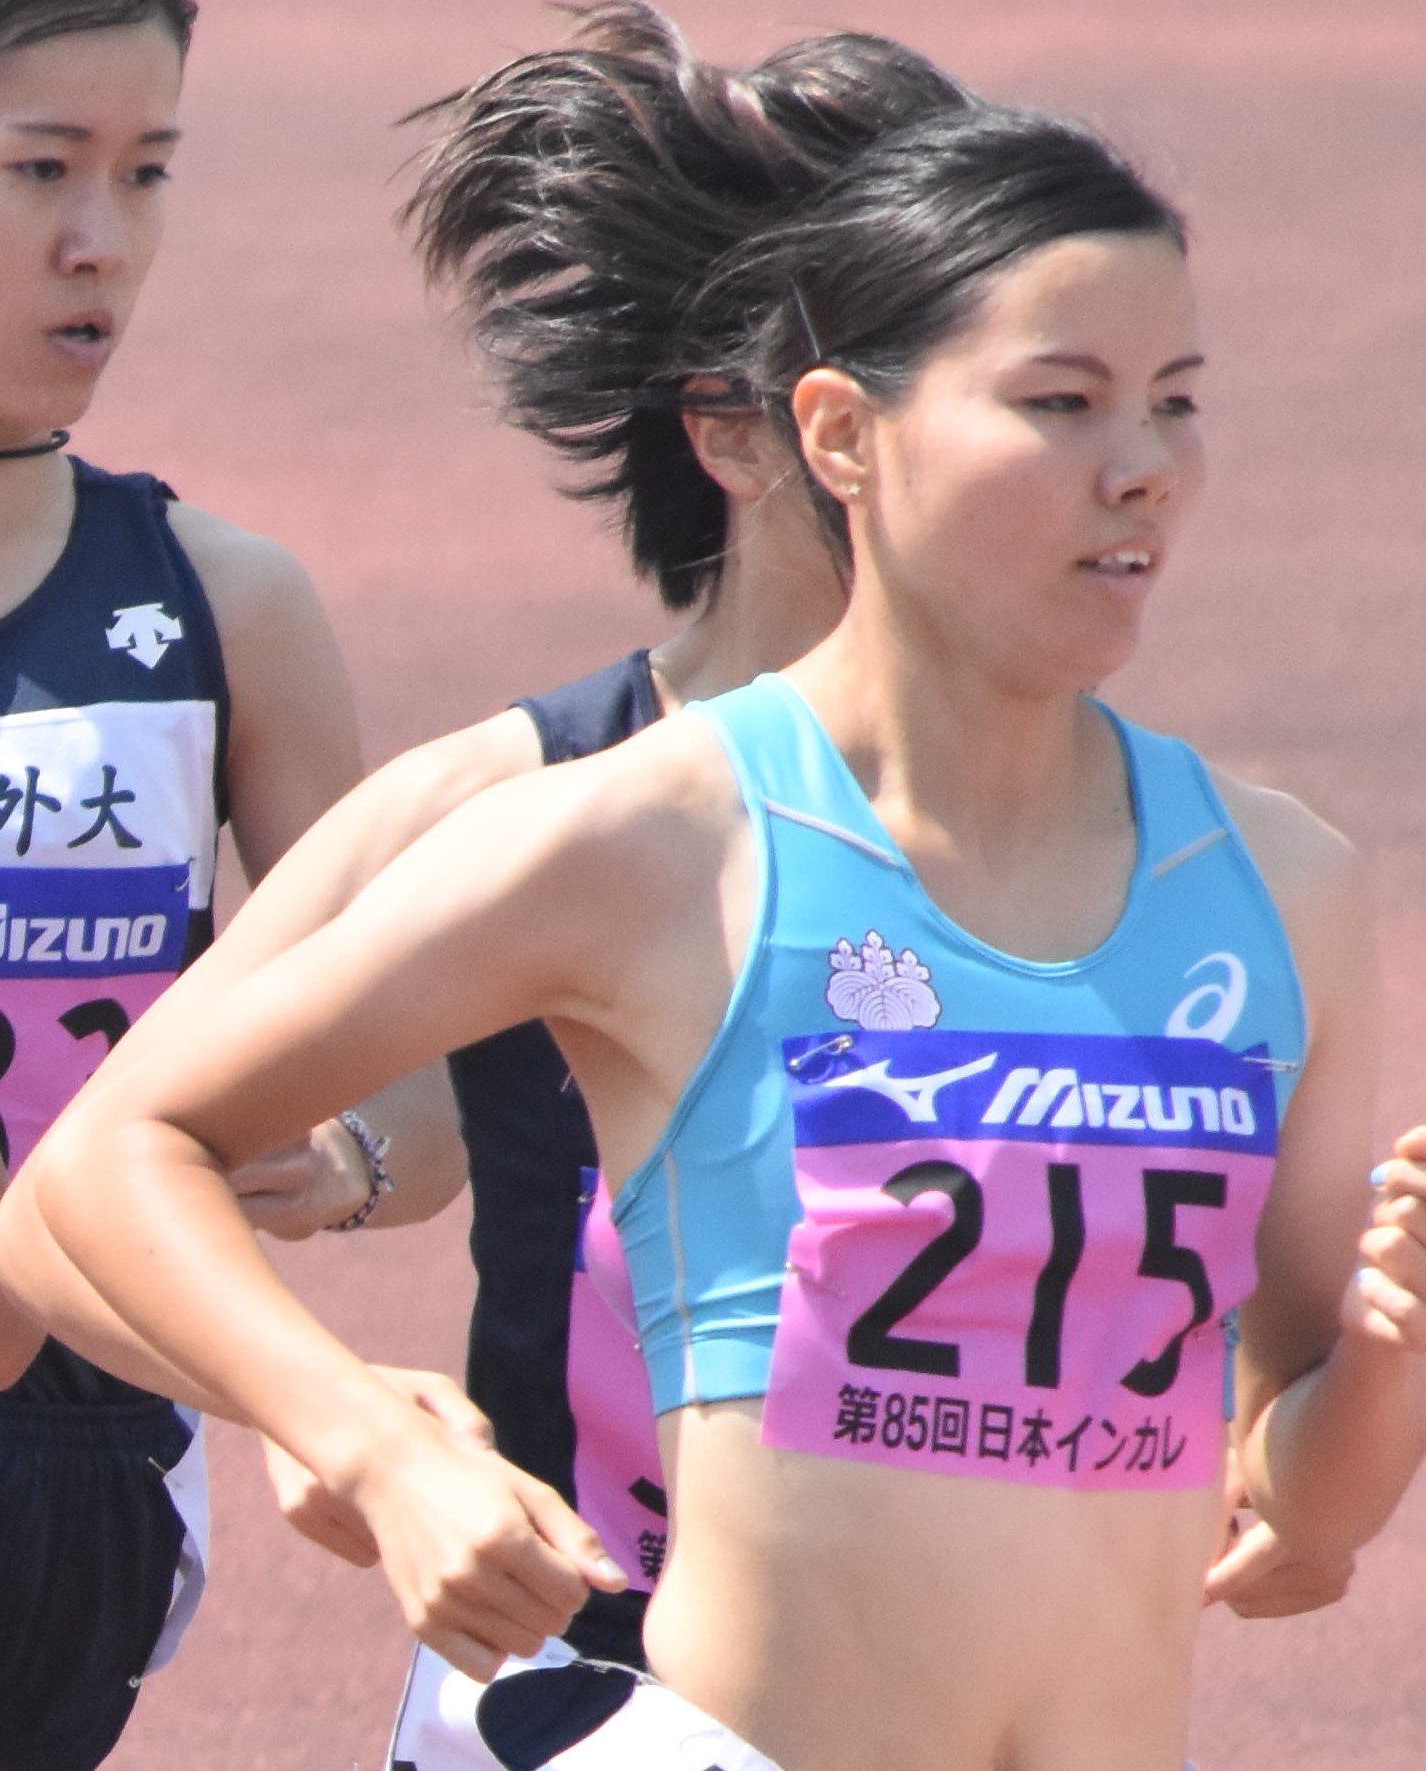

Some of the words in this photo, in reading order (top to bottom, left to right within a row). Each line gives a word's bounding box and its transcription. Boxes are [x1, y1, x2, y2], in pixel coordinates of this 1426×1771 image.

[982, 1068, 1255, 1137] MIZUNO
[847, 1159, 1228, 1397] 215
[832, 1383, 1187, 1472] 第85回日本インカレ
